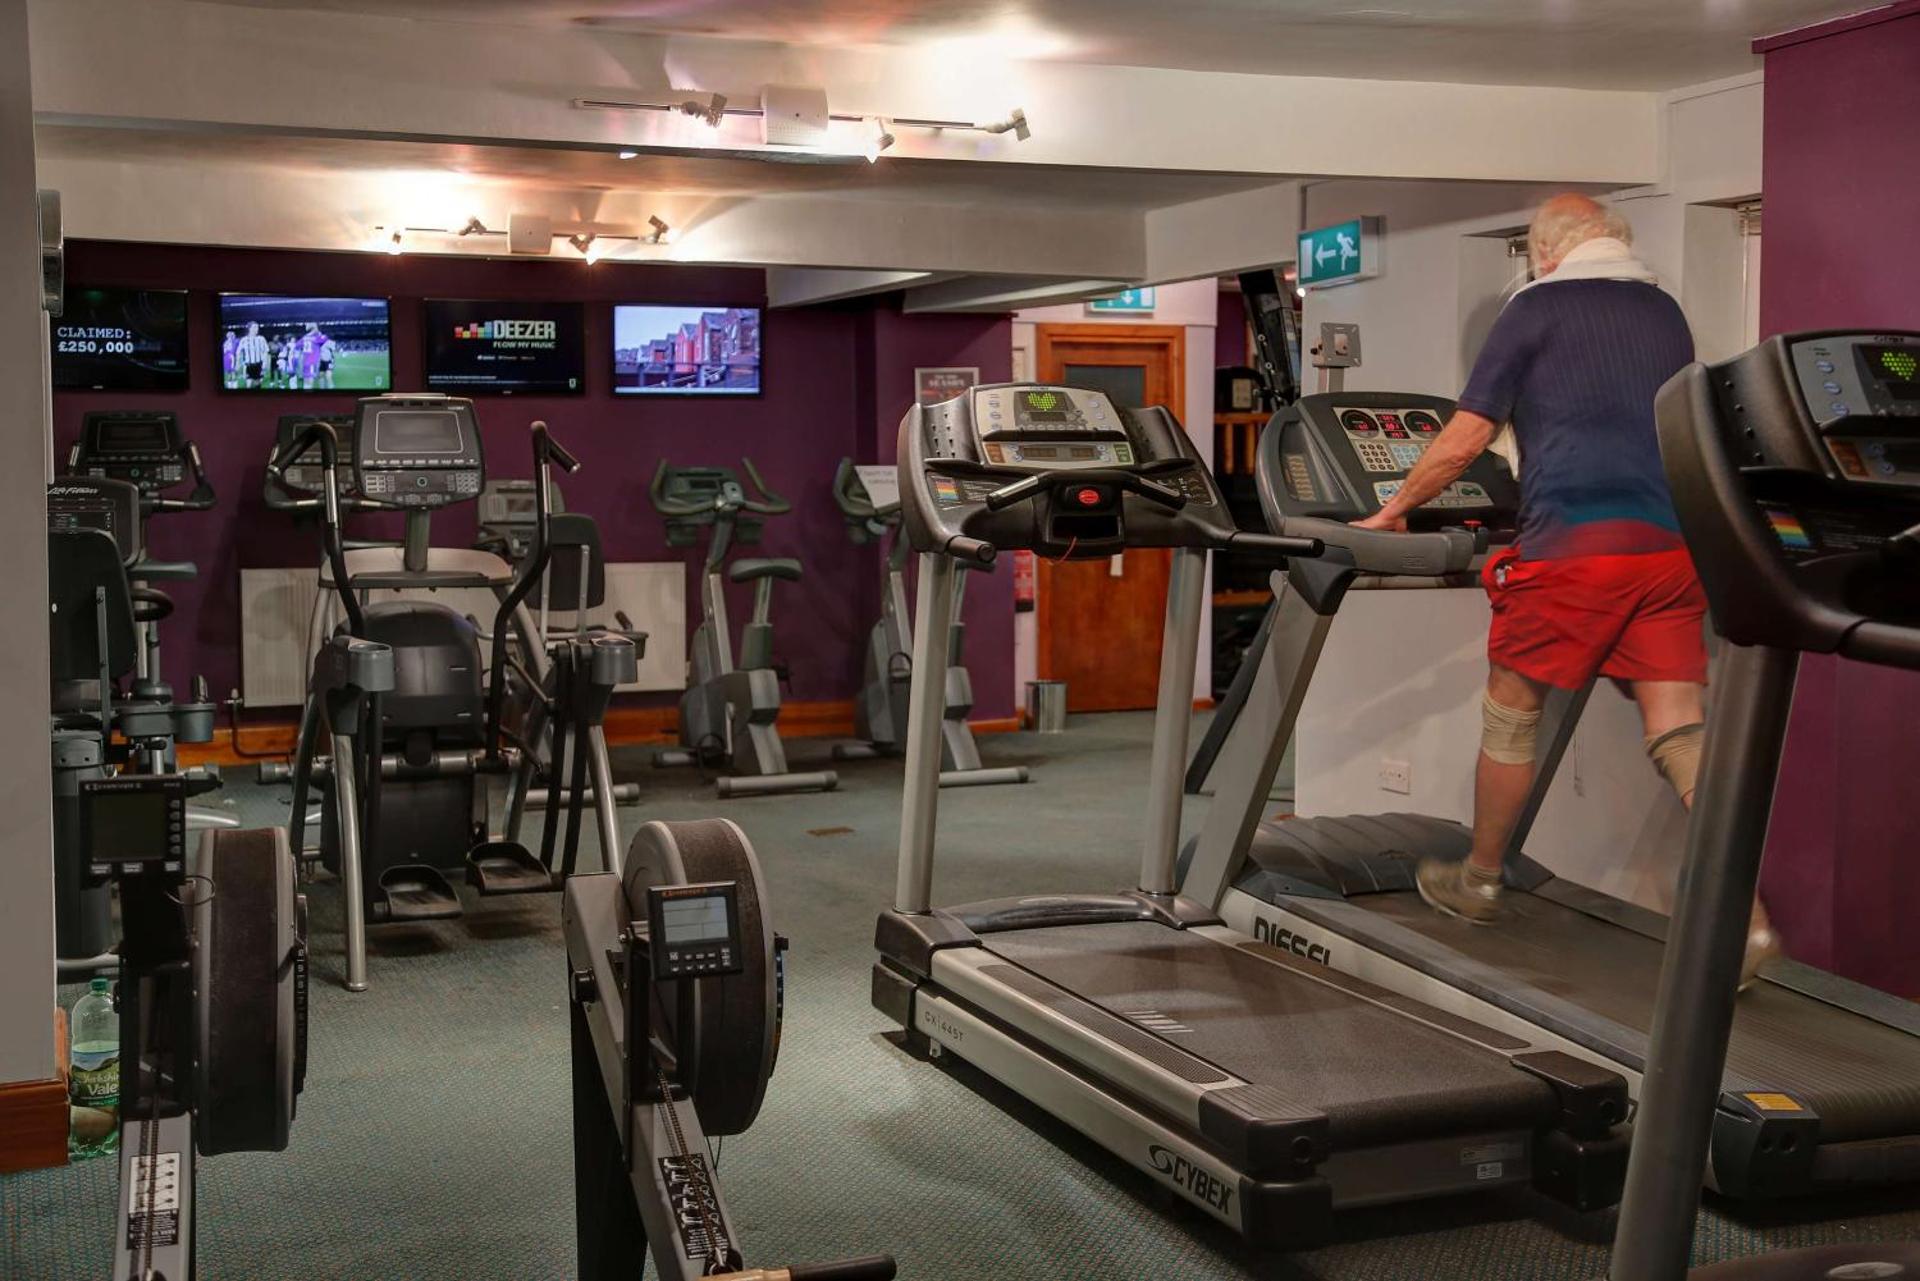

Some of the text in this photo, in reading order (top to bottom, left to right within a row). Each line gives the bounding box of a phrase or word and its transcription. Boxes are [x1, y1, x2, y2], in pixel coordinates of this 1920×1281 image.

[57, 327, 131, 339] CLAIMED:
[493, 320, 556, 339] DEEZER
[58, 341, 134, 354] £250,000
[1173, 1156, 1234, 1215] CYBEX
